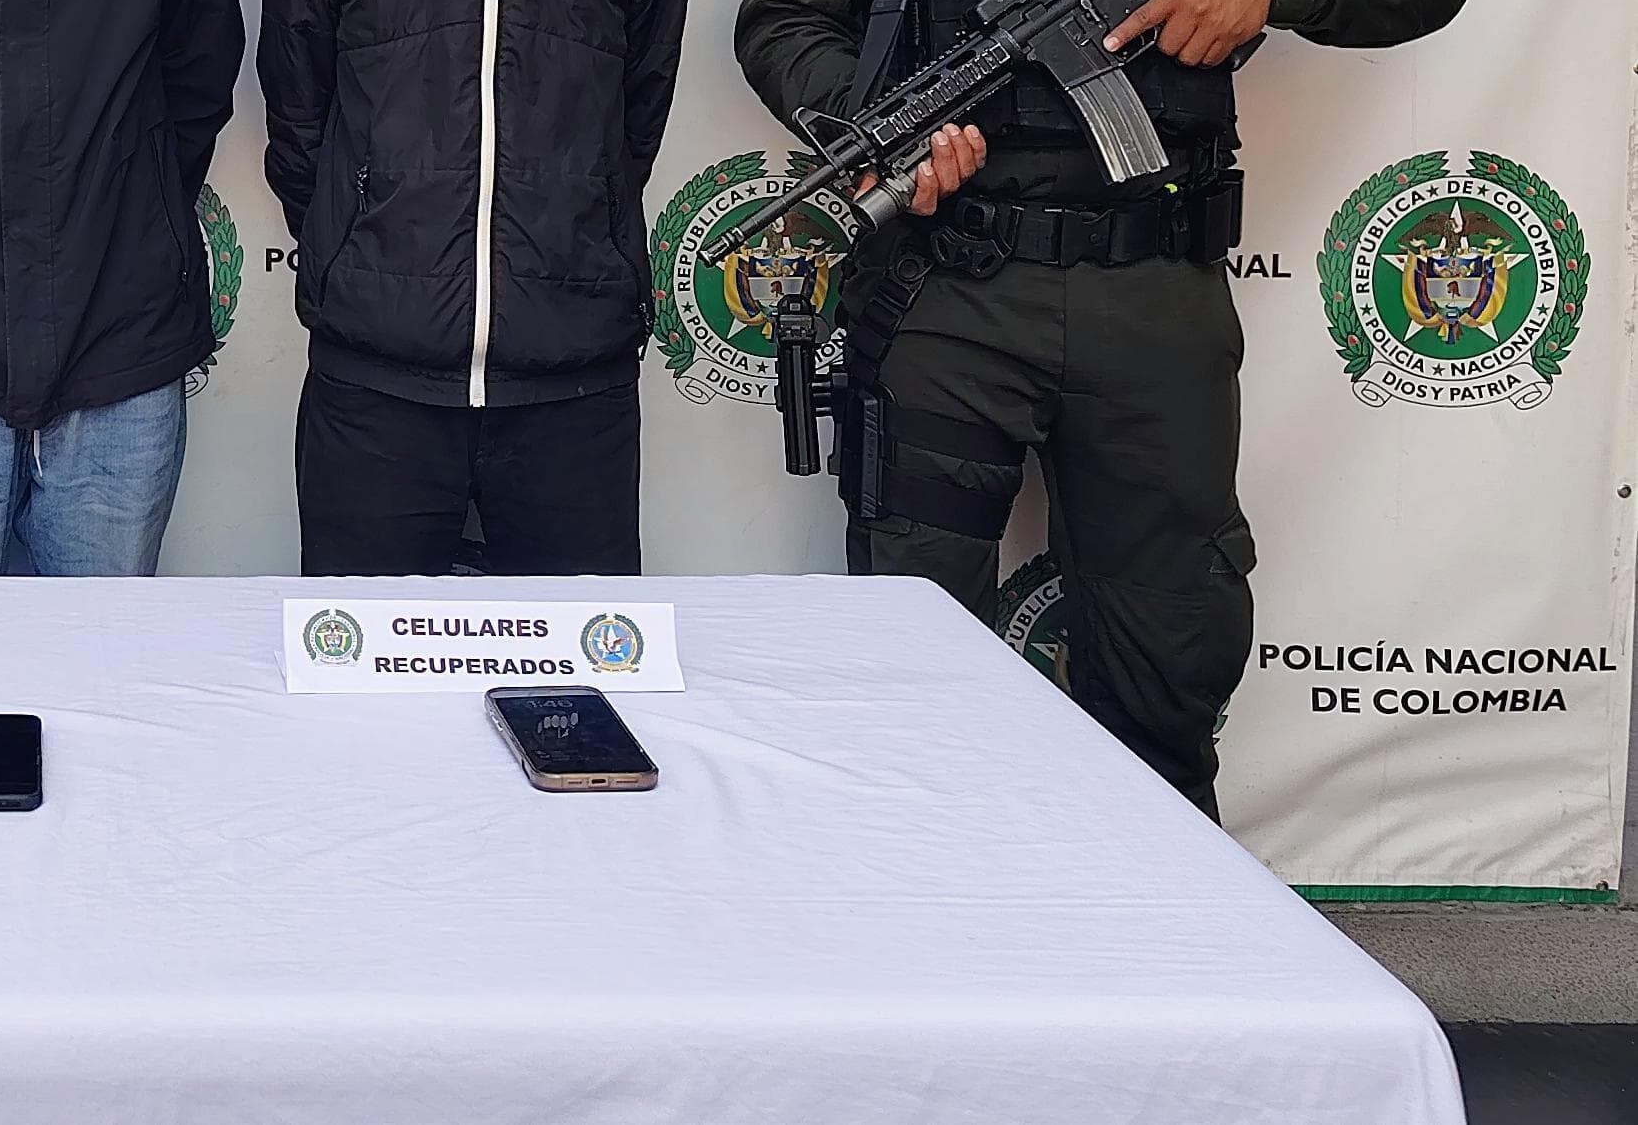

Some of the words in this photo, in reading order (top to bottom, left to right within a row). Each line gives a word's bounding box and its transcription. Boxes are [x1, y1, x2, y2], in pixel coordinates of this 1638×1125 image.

[1445, 181, 1473, 195] DE
[1494, 192, 1554, 293] COLOMBIA
[1451, 316, 1545, 378] NACIONAL
[1450, 374, 1520, 401] PATRIA
[393, 618, 548, 637] CELULARES
[375, 658, 574, 674] RECUPERADOS
[1260, 641, 1414, 672] POLICÍA
[1426, 648, 1616, 674] NACIONAL
[1312, 687, 1360, 713] DE
[1373, 689, 1566, 714] COLOMBIA
